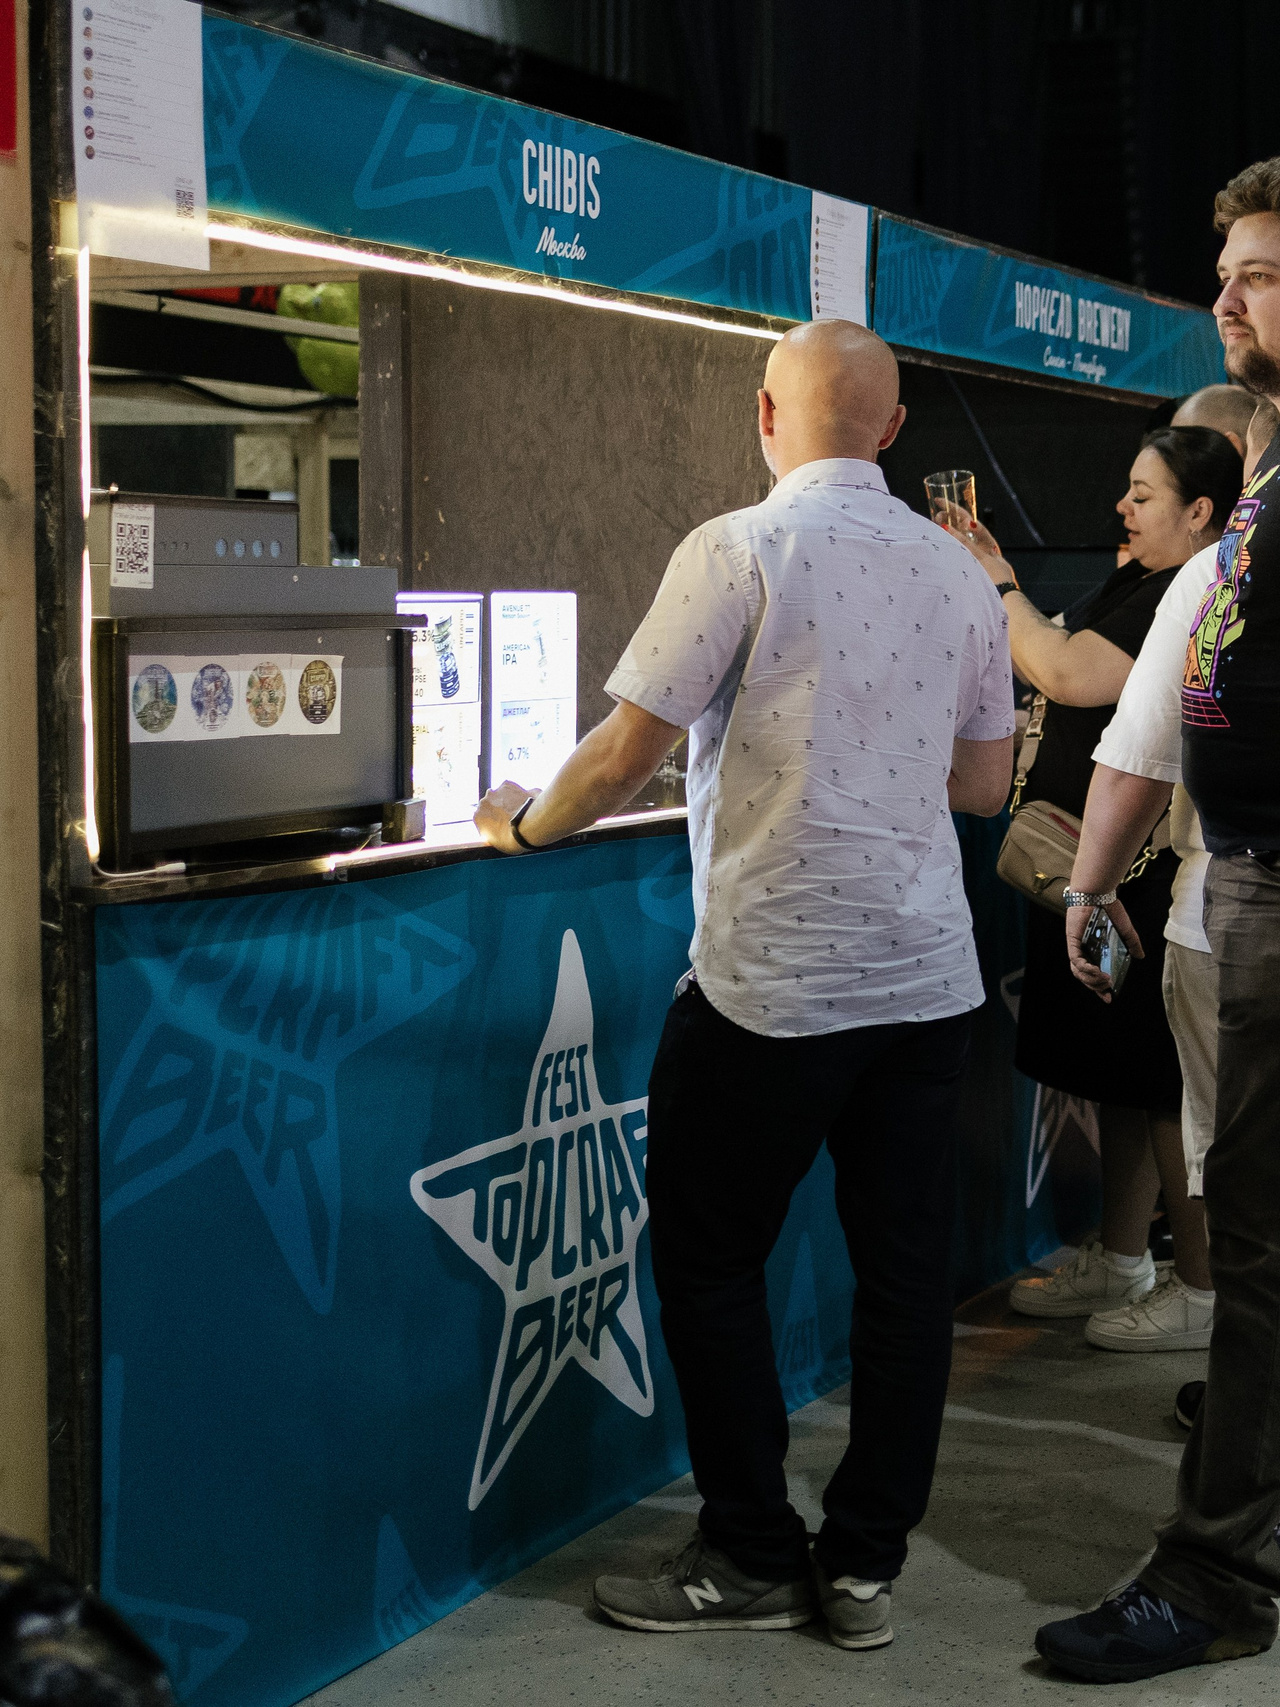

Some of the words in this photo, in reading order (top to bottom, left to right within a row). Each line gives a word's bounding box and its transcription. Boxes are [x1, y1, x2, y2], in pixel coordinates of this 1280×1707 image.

[522, 138, 601, 219] CHIBIS
[535, 226, 587, 260] Москва
[1015, 281, 1073, 339] HOPHEAD
[1077, 298, 1131, 352] BREWERY
[502, 604, 524, 612] AVENUE
[502, 644, 531, 652] AMERICAN
[502, 653, 518, 666] IPA
[502, 706, 531, 718] ДЖЕТЛАГ
[507, 747, 530, 761] 6.7%
[532, 1043, 589, 1127] FEST
[422, 1108, 648, 1293] TOPCRAF
[480, 1261, 648, 1485] BEER
